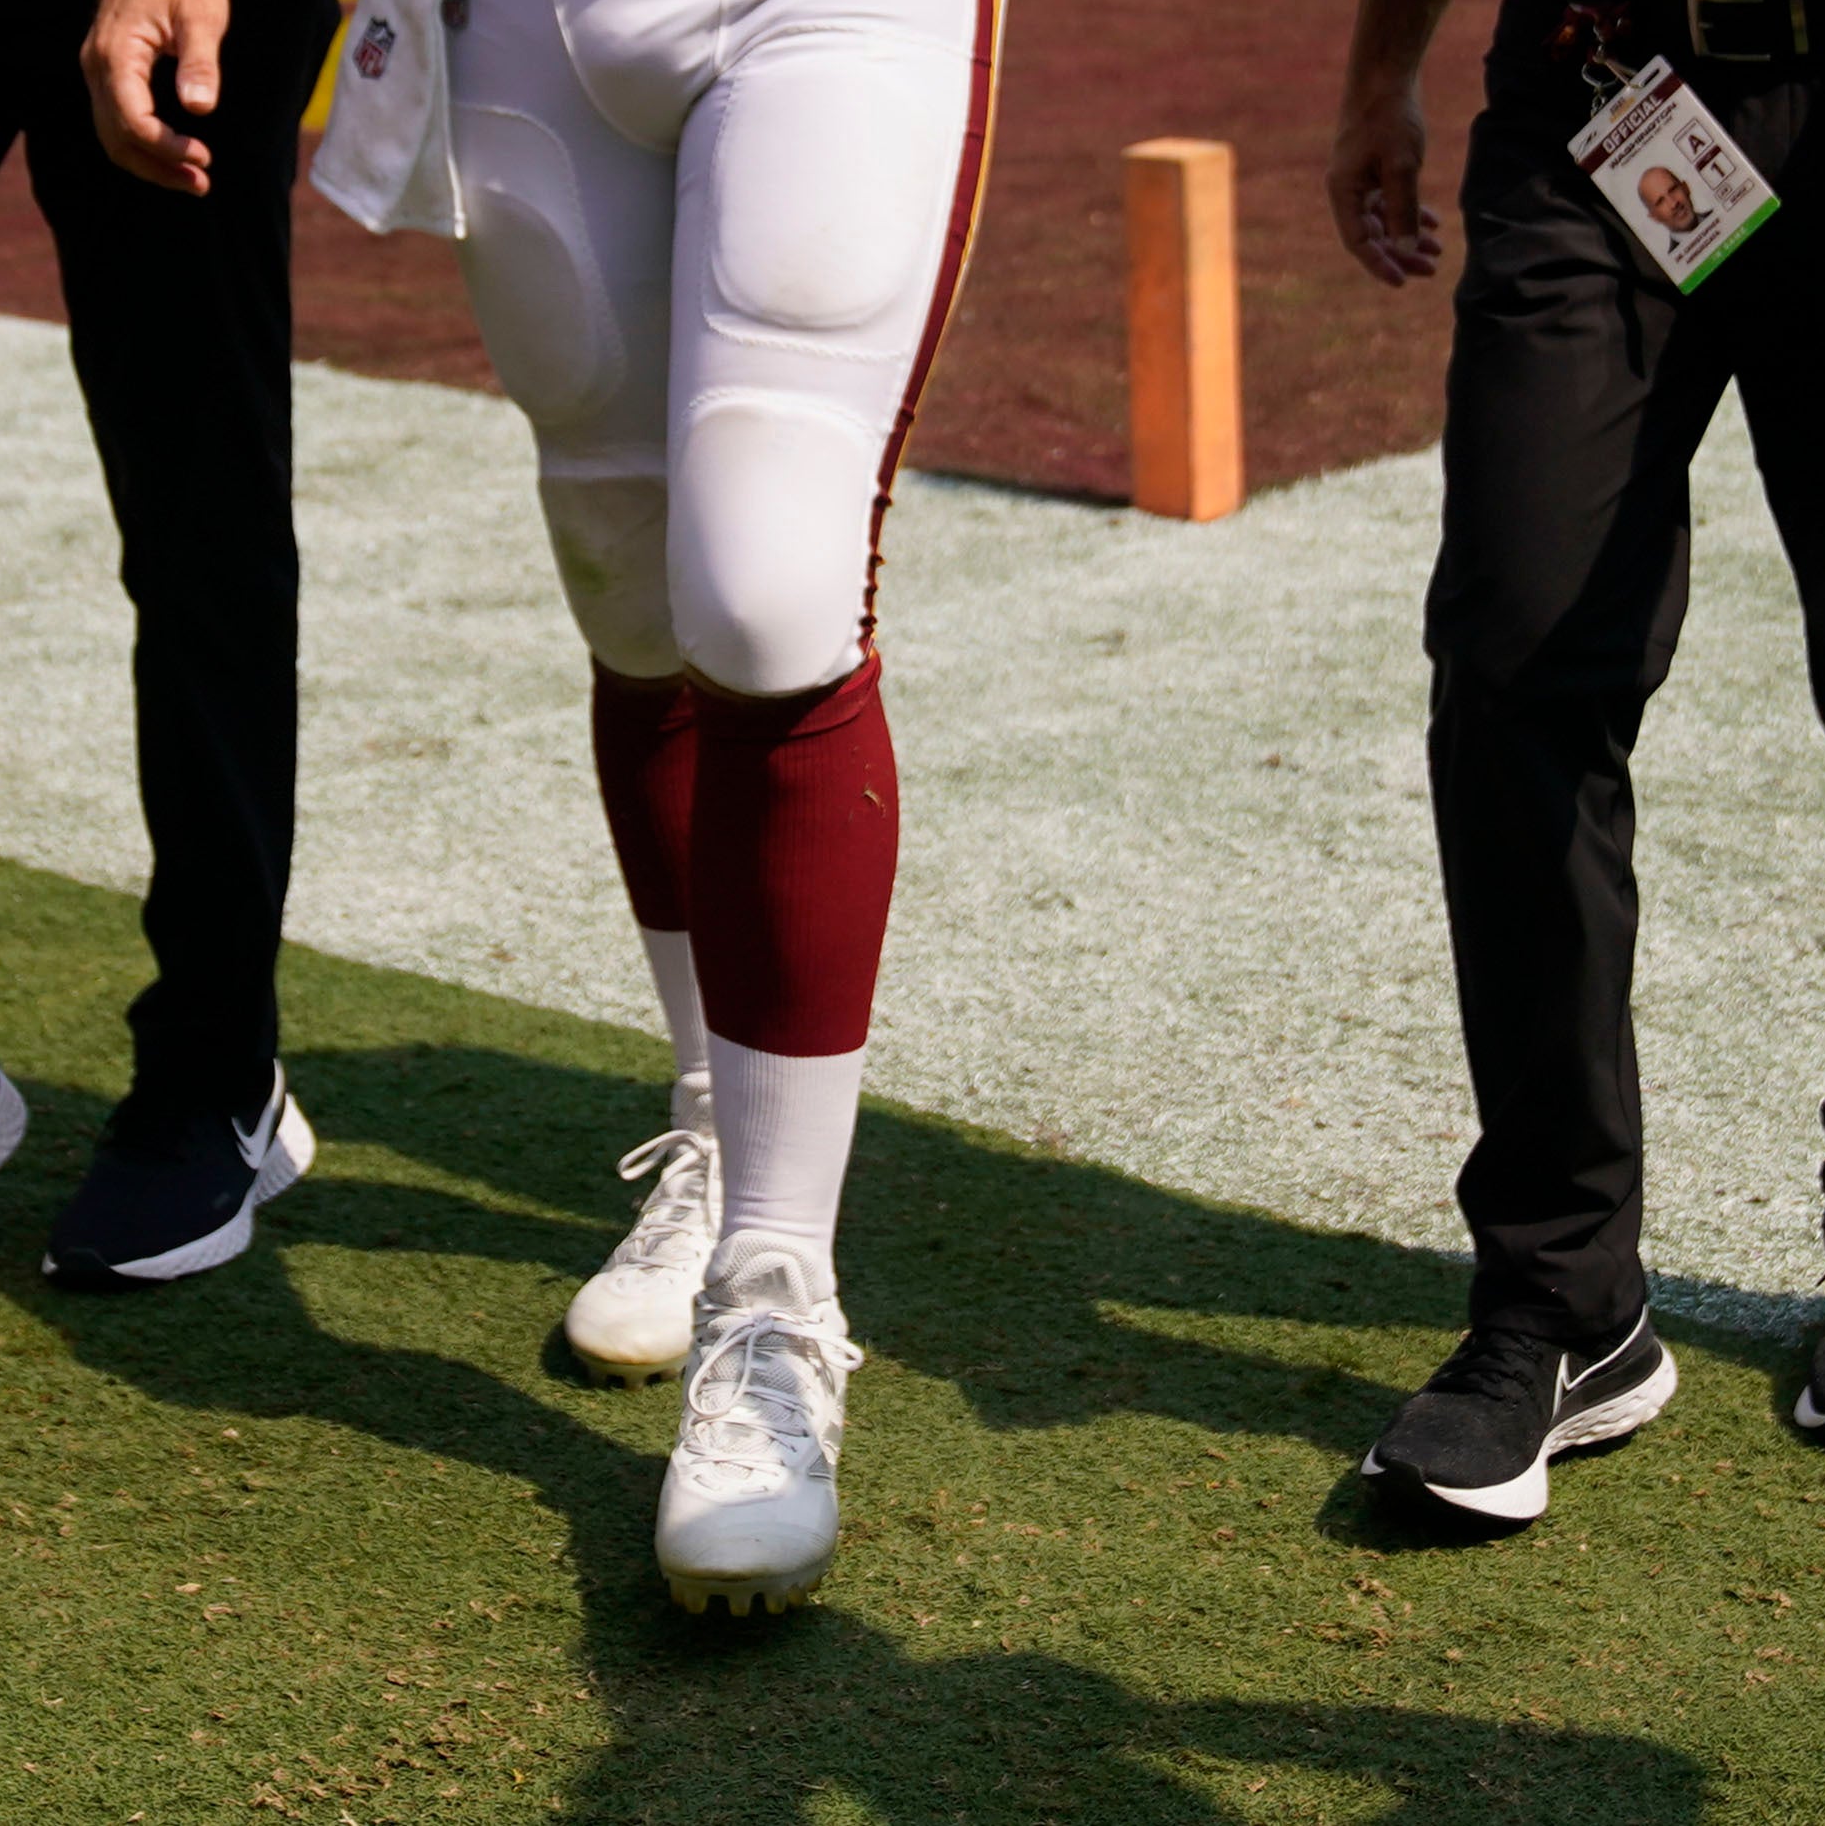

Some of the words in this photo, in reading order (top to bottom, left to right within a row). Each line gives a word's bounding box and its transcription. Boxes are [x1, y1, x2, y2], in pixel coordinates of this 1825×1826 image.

[1600, 91, 1664, 154] OFFICIAL
[1607, 100, 1677, 170] WASHINGTON
[1688, 135, 1705, 155] A
[1708, 161, 1726, 178] 1
